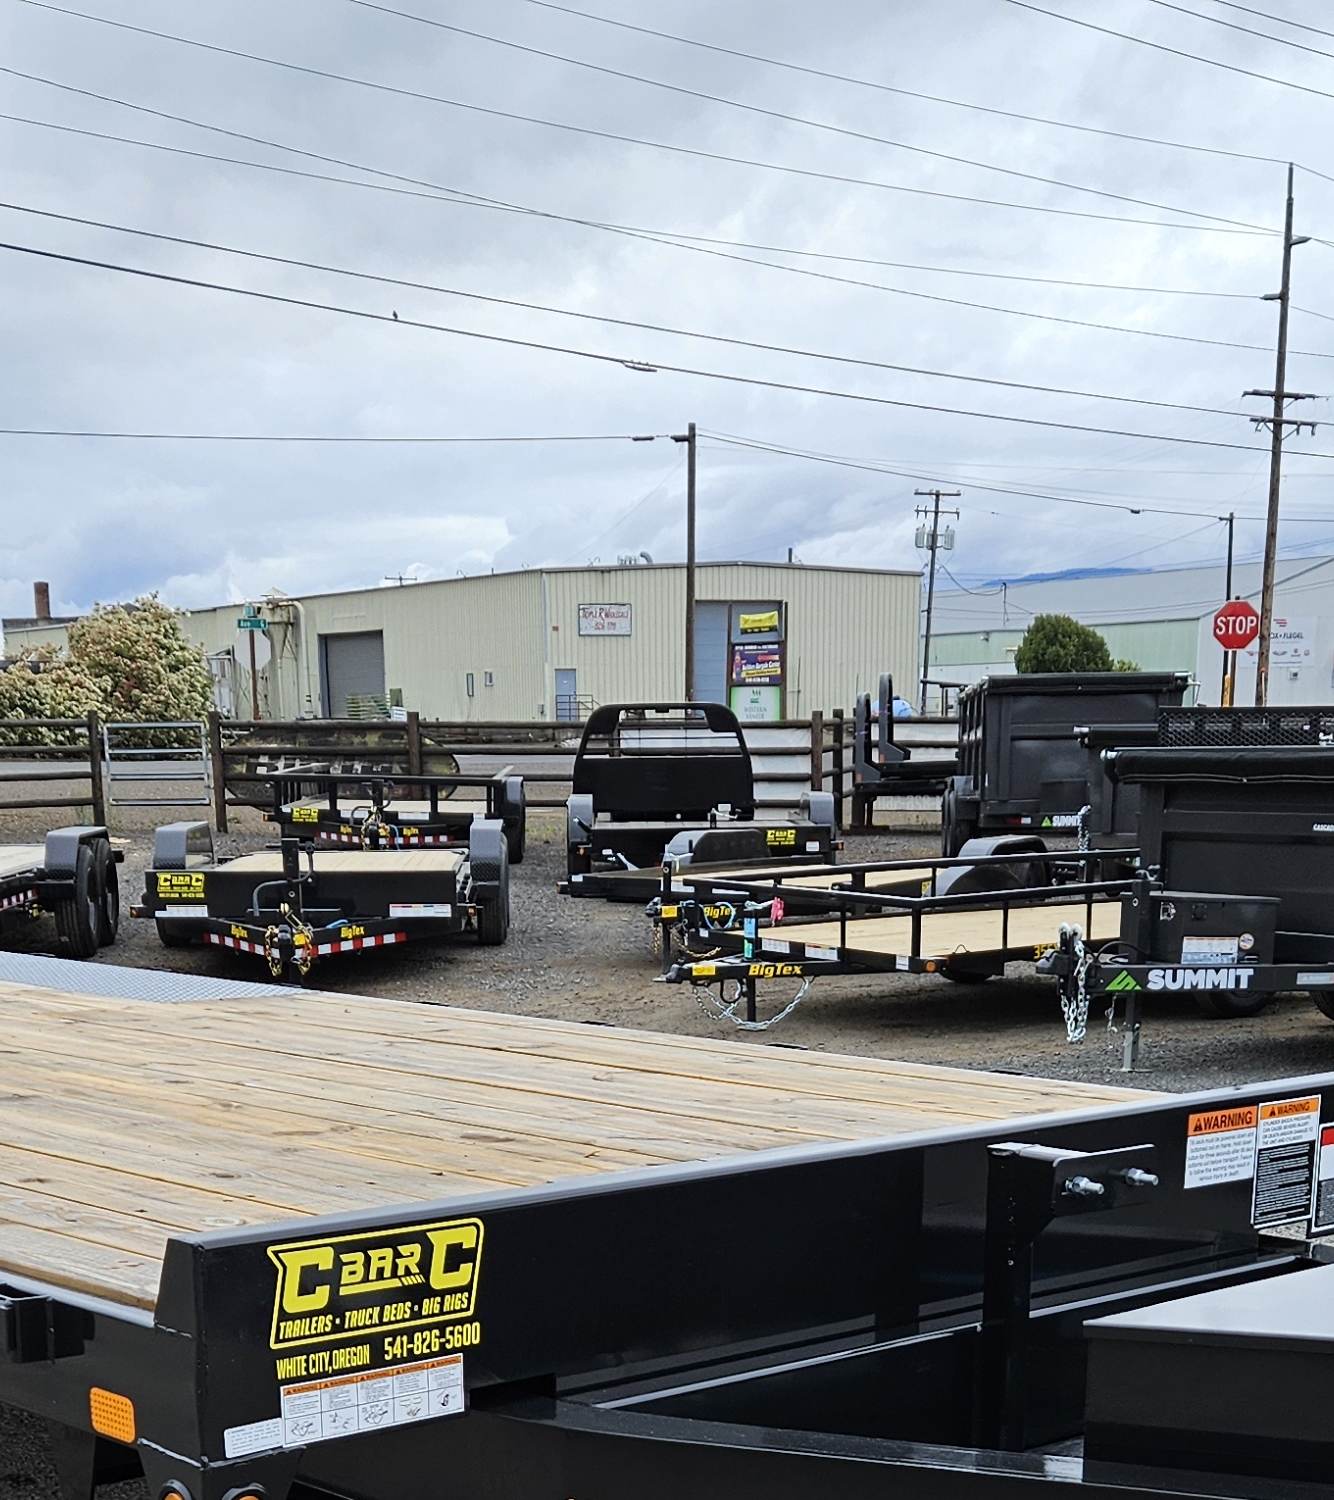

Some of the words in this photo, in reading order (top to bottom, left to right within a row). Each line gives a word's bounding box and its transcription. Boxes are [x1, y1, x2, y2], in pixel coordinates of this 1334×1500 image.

[1216, 616, 1257, 635] STOP
[341, 925, 365, 938] BigTex
[749, 963, 802, 978] BigTex
[1147, 969, 1254, 990] SUMMIT
[1277, 1101, 1310, 1116] WARNING
[1203, 1111, 1253, 1131] WARNING
[278, 1246, 334, 1313] C
[339, 1243, 422, 1285] BAR
[426, 1225, 477, 1290] C
[279, 1315, 333, 1340] TRAILERS
[344, 1305, 380, 1329] TRUCK
[383, 1301, 411, 1323] BEDS
[422, 1296, 441, 1316] BIG
[443, 1292, 469, 1312] RIGS
[276, 1355, 307, 1380] WHITE
[384, 1322, 481, 1361] 541-826-5600
